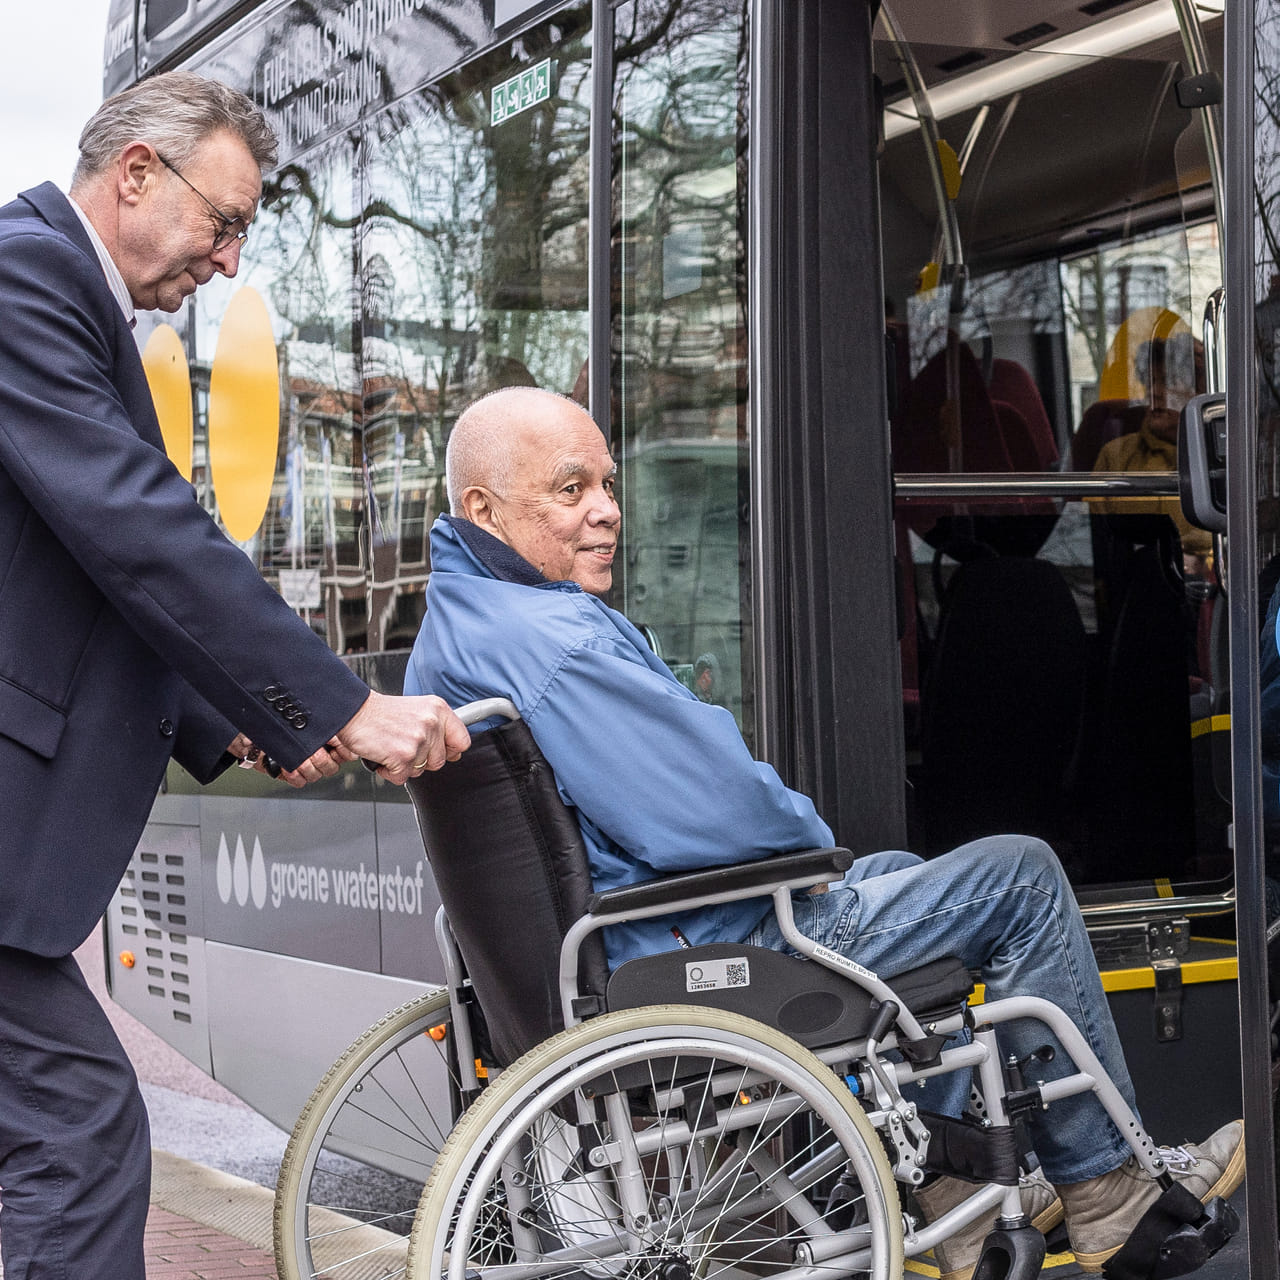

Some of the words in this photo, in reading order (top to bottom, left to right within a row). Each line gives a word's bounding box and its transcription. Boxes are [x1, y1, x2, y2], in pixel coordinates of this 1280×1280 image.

[264, 46, 292, 109] FUEL
[334, 0, 363, 60] AND
[296, 53, 381, 144] UNDERTAKING
[271, 862, 329, 908] groene
[332, 860, 424, 915] waterstof
